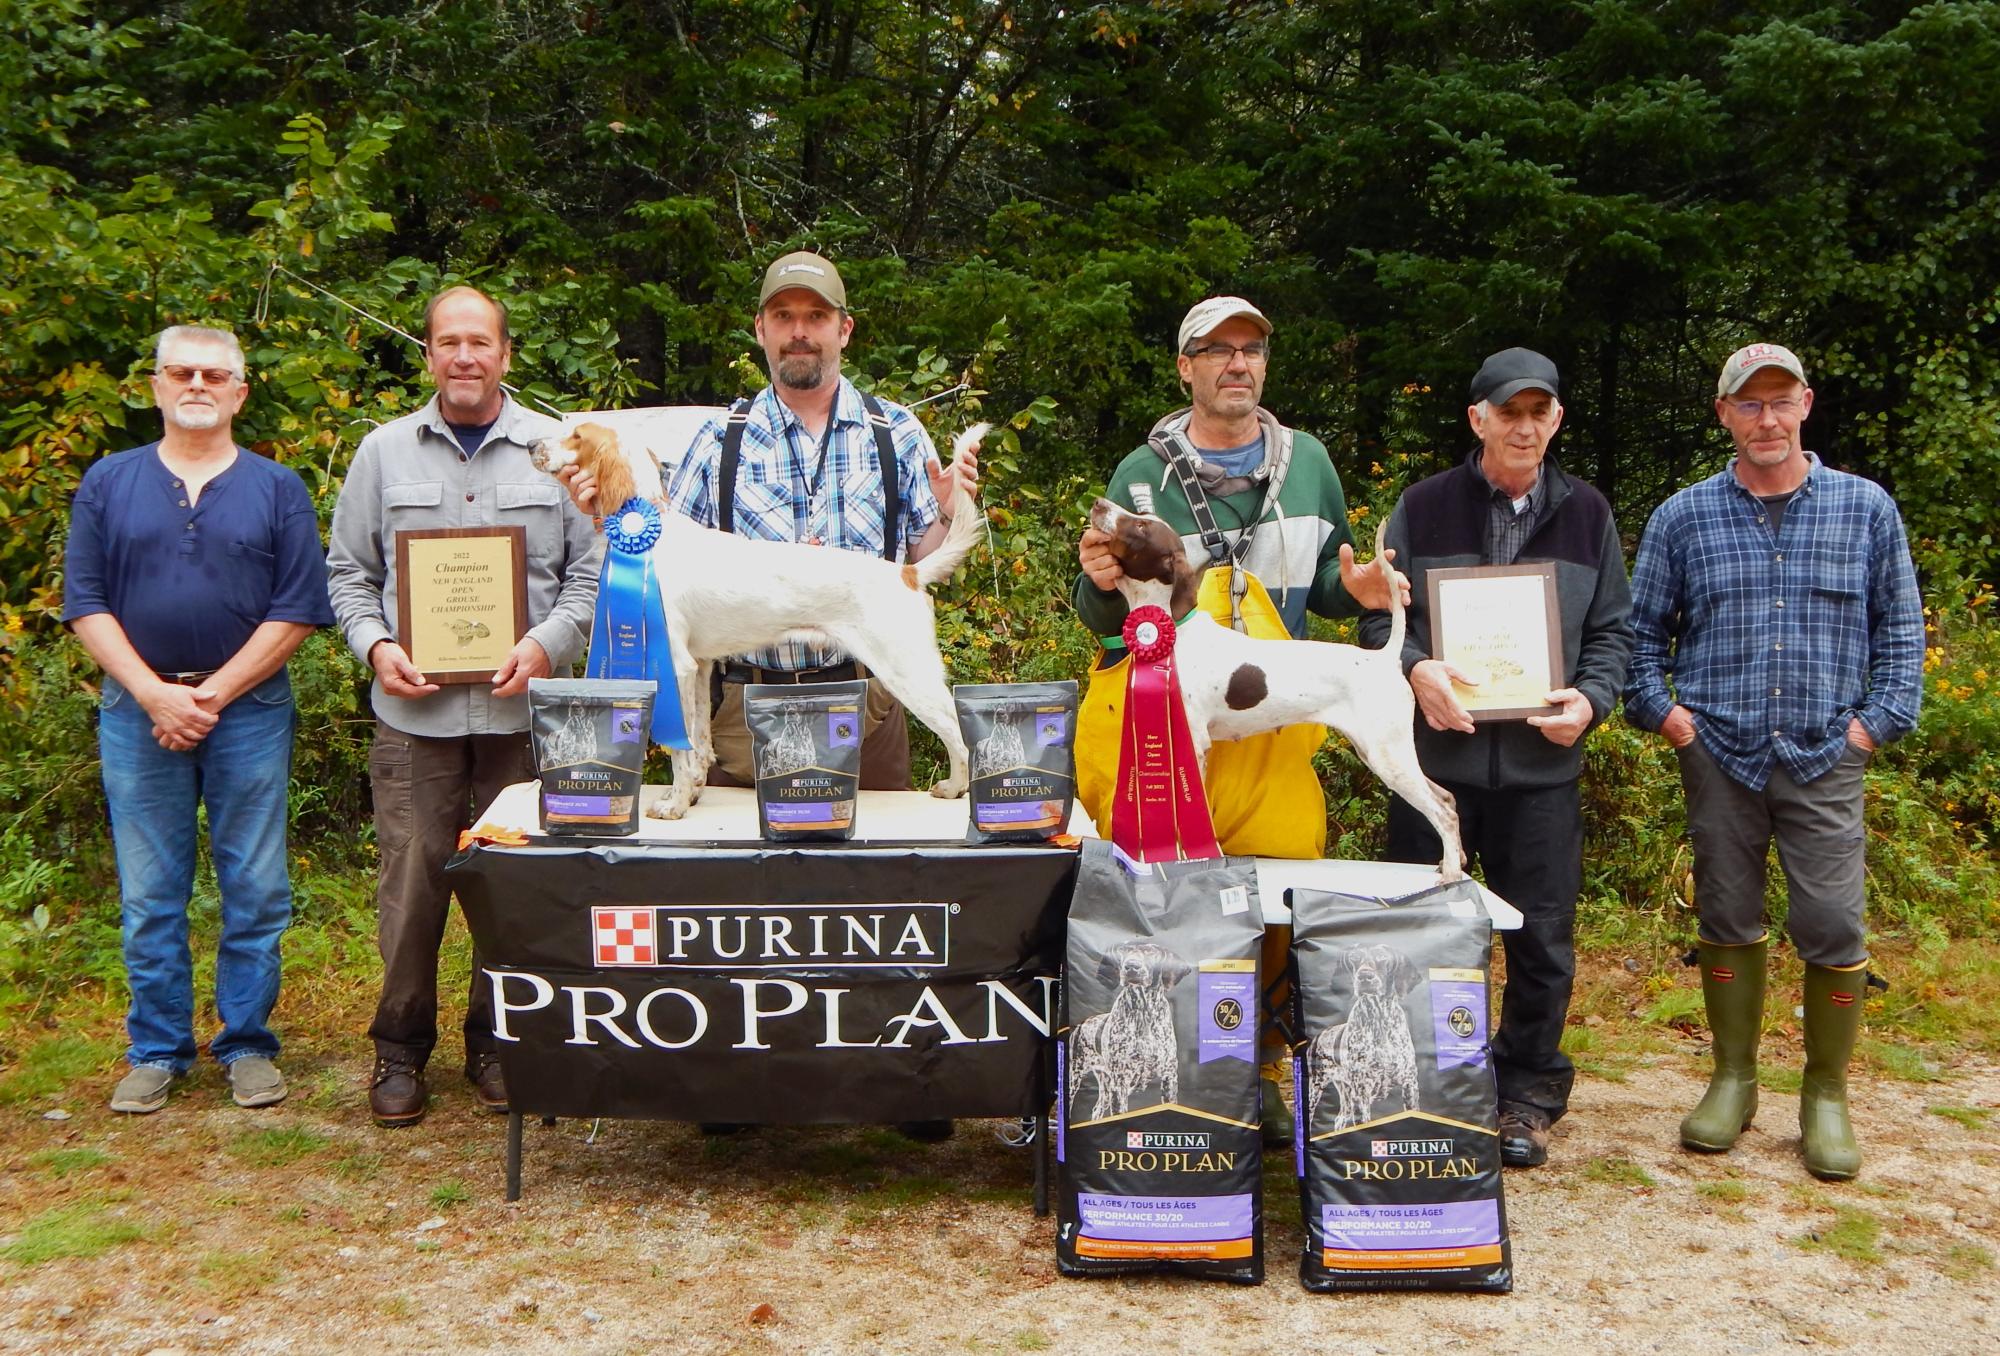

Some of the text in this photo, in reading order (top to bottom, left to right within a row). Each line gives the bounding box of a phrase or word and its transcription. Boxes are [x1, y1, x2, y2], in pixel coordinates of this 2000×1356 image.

[453, 552, 470, 560] 2022
[435, 562, 489, 575] Champion
[453, 576, 493, 585] ENGLAND
[446, 596, 480, 604] GROUSE
[431, 604, 496, 614] CHAMPIONSHIP
[558, 780, 622, 790] PRO PLAN
[1127, 766, 1136, 803] RUNNER-UP
[1178, 766, 1192, 803] RUNNER-UP
[780, 786, 842, 798] PRO PLAN
[991, 786, 1052, 798] PRO PLAN
[667, 914, 935, 959] PURINA
[482, 967, 709, 1049] PRO
[731, 976, 1059, 1049] PLAN
[1144, 1135, 1206, 1147] PURINA
[1389, 1142, 1449, 1154] PURINA
[1098, 1151, 1237, 1172] PRO PLAN
[1343, 1158, 1478, 1180] PRO PLAN
[1083, 1198, 1197, 1209] ALL AGES / TOUS LES ÂGES
[1083, 1210, 1183, 1222] PERFORMANCE 30/20
[1329, 1207, 1443, 1218] ALL AGES / TOUS LES ÂGES
[1328, 1221, 1431, 1230] PERFORMANCE 30/20
